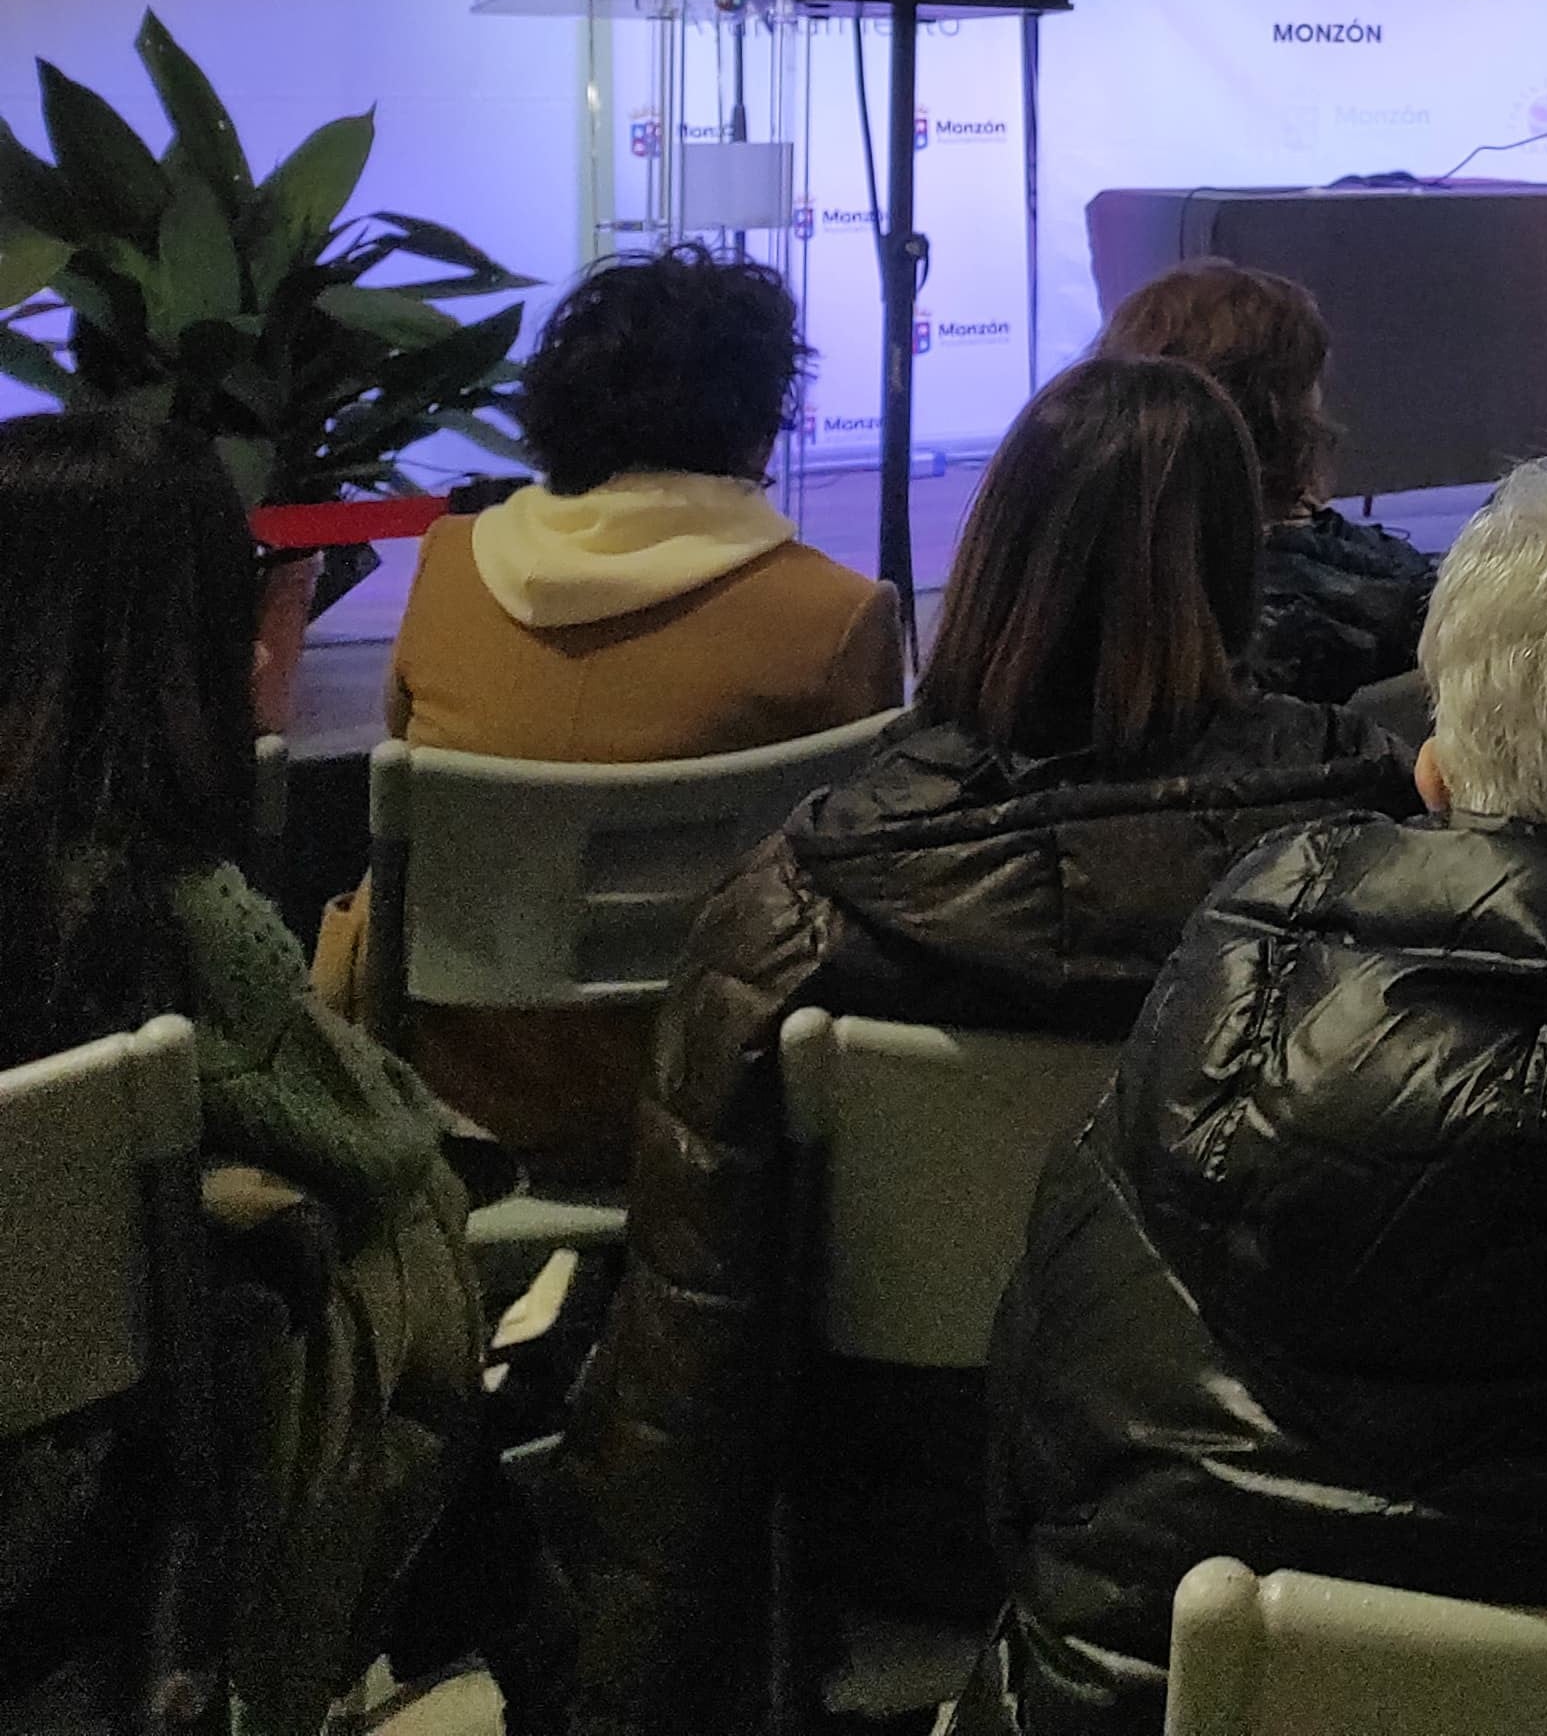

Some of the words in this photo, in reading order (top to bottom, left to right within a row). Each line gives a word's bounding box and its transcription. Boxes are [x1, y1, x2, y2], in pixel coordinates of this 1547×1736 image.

[1273, 18, 1384, 44] MONZÓN
[936, 119, 1008, 137] Monzón
[938, 319, 1012, 338] Monzón
